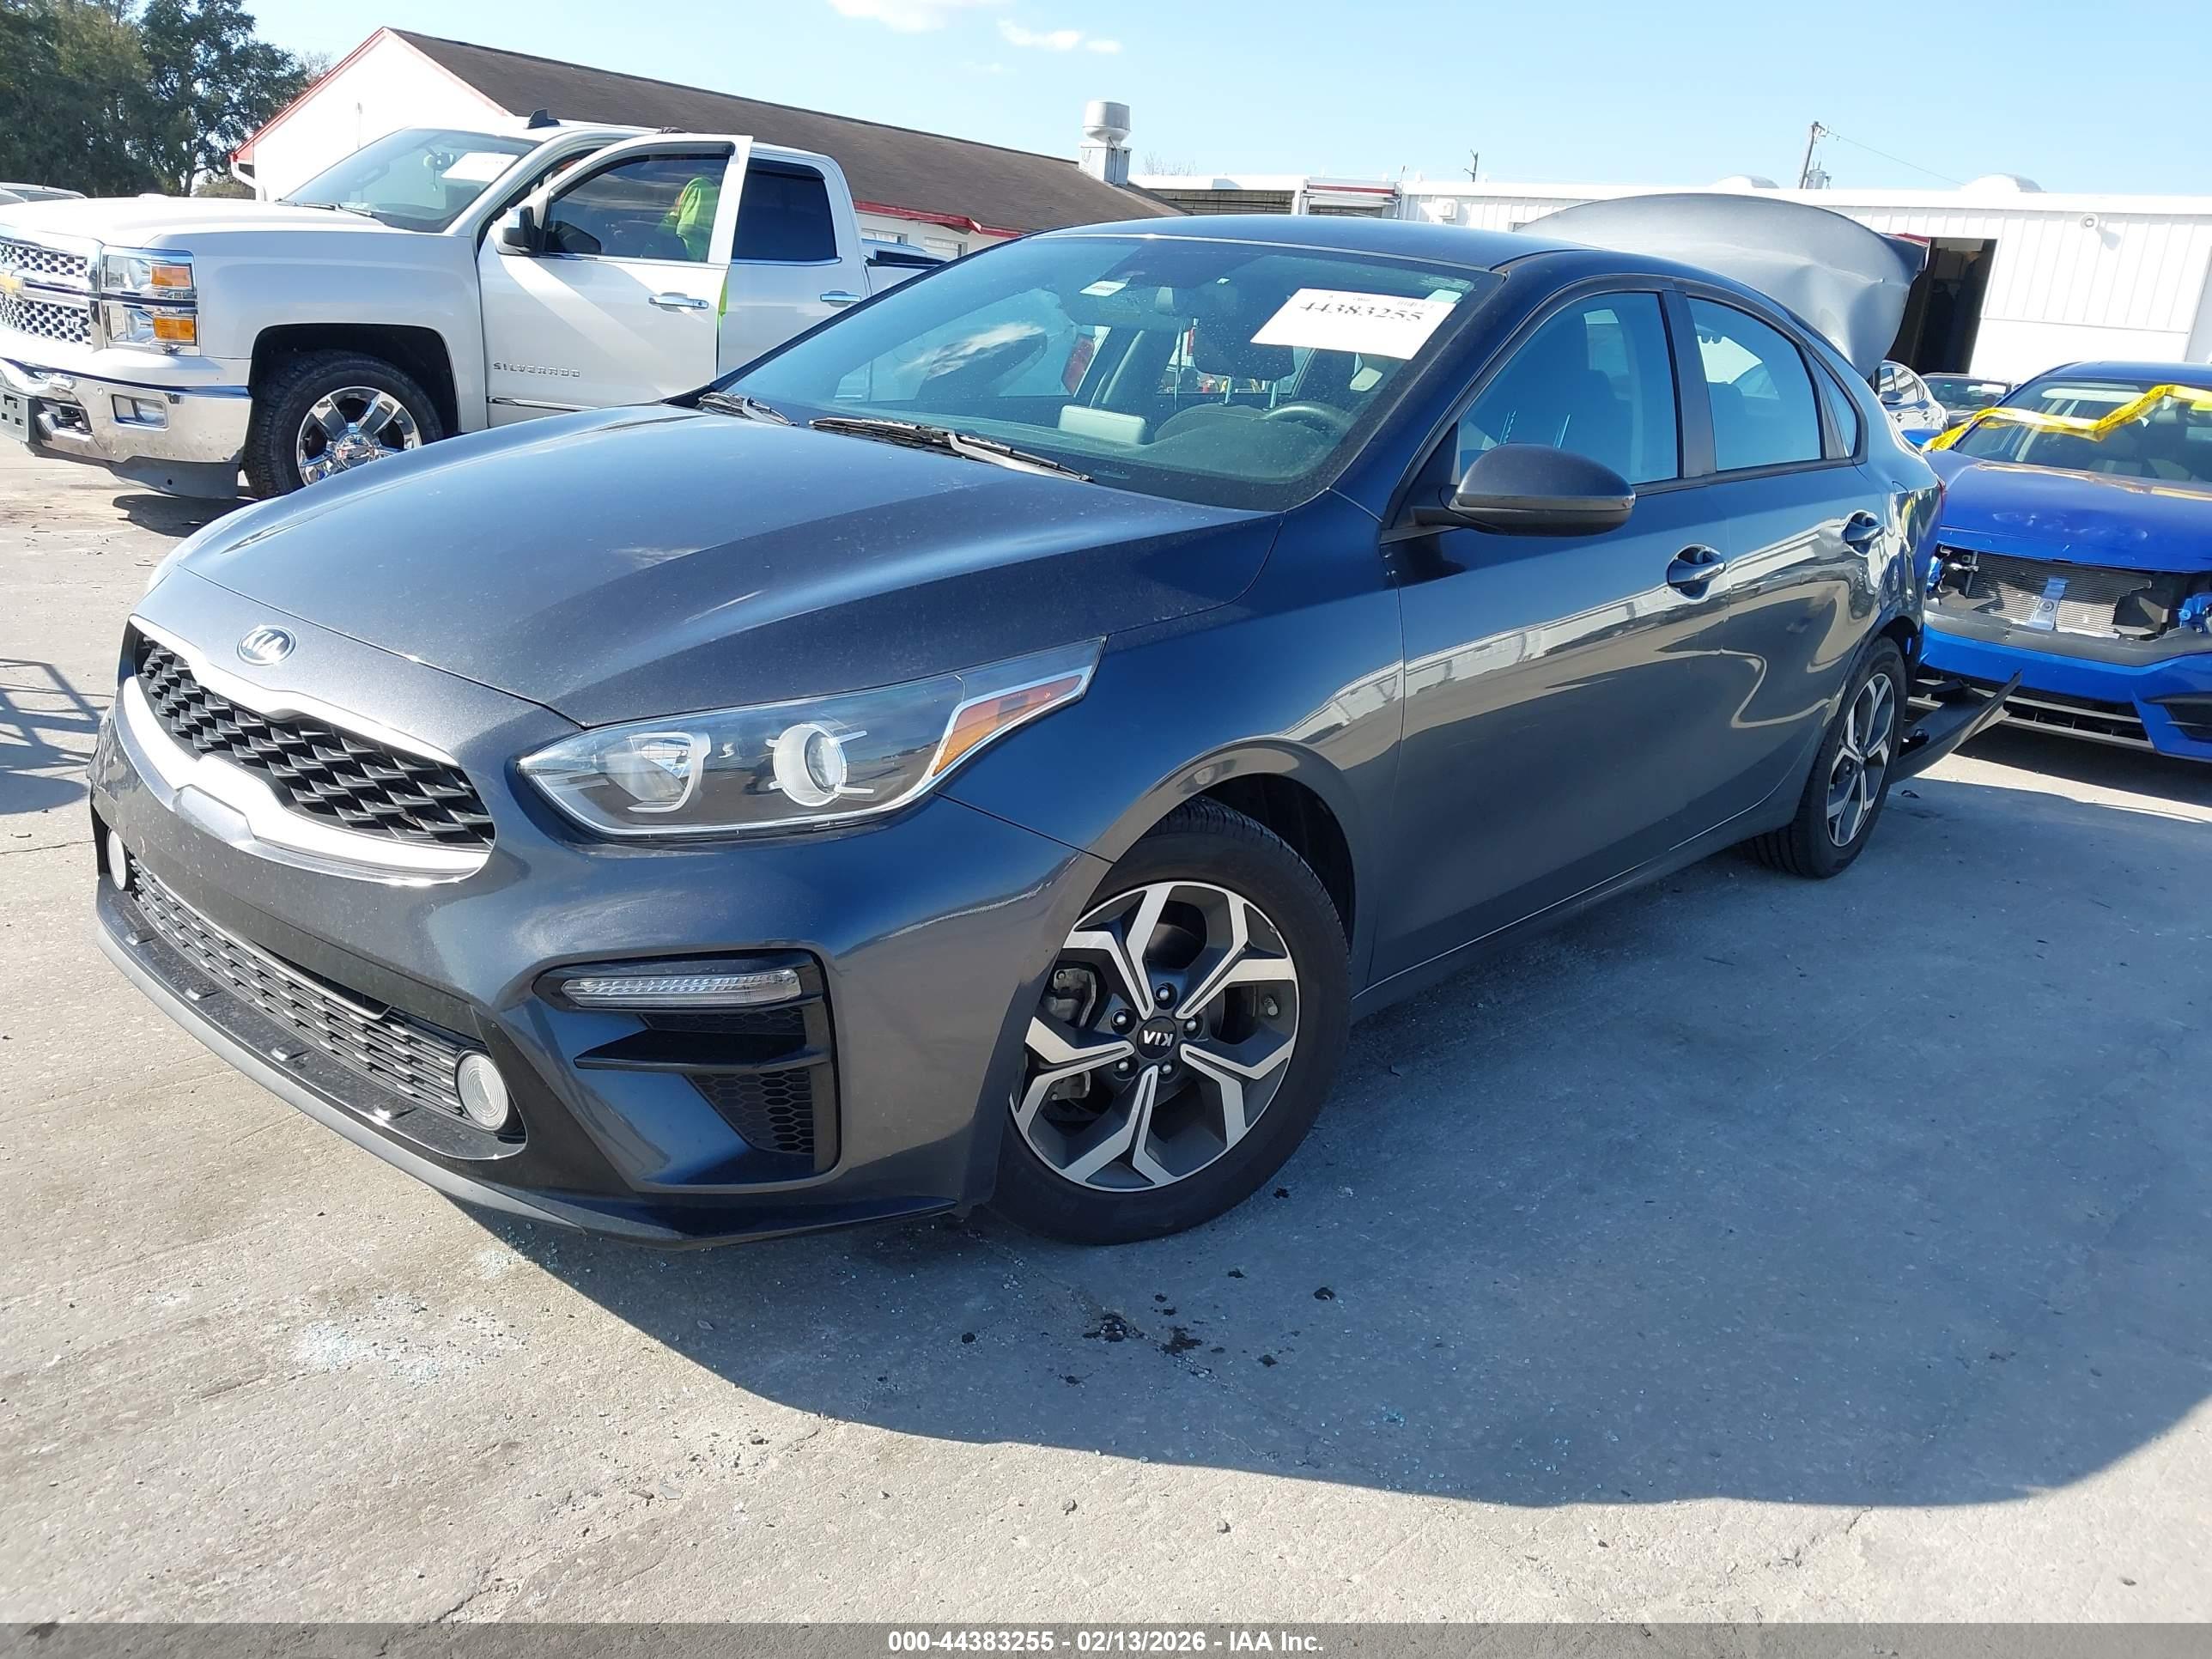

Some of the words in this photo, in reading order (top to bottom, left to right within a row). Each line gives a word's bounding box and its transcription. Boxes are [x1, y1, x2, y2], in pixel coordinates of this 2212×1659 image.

[1299, 301, 1425, 322] 44383255
[493, 362, 580, 378] SILVERADO
[1143, 1030, 1174, 1047] KIA
